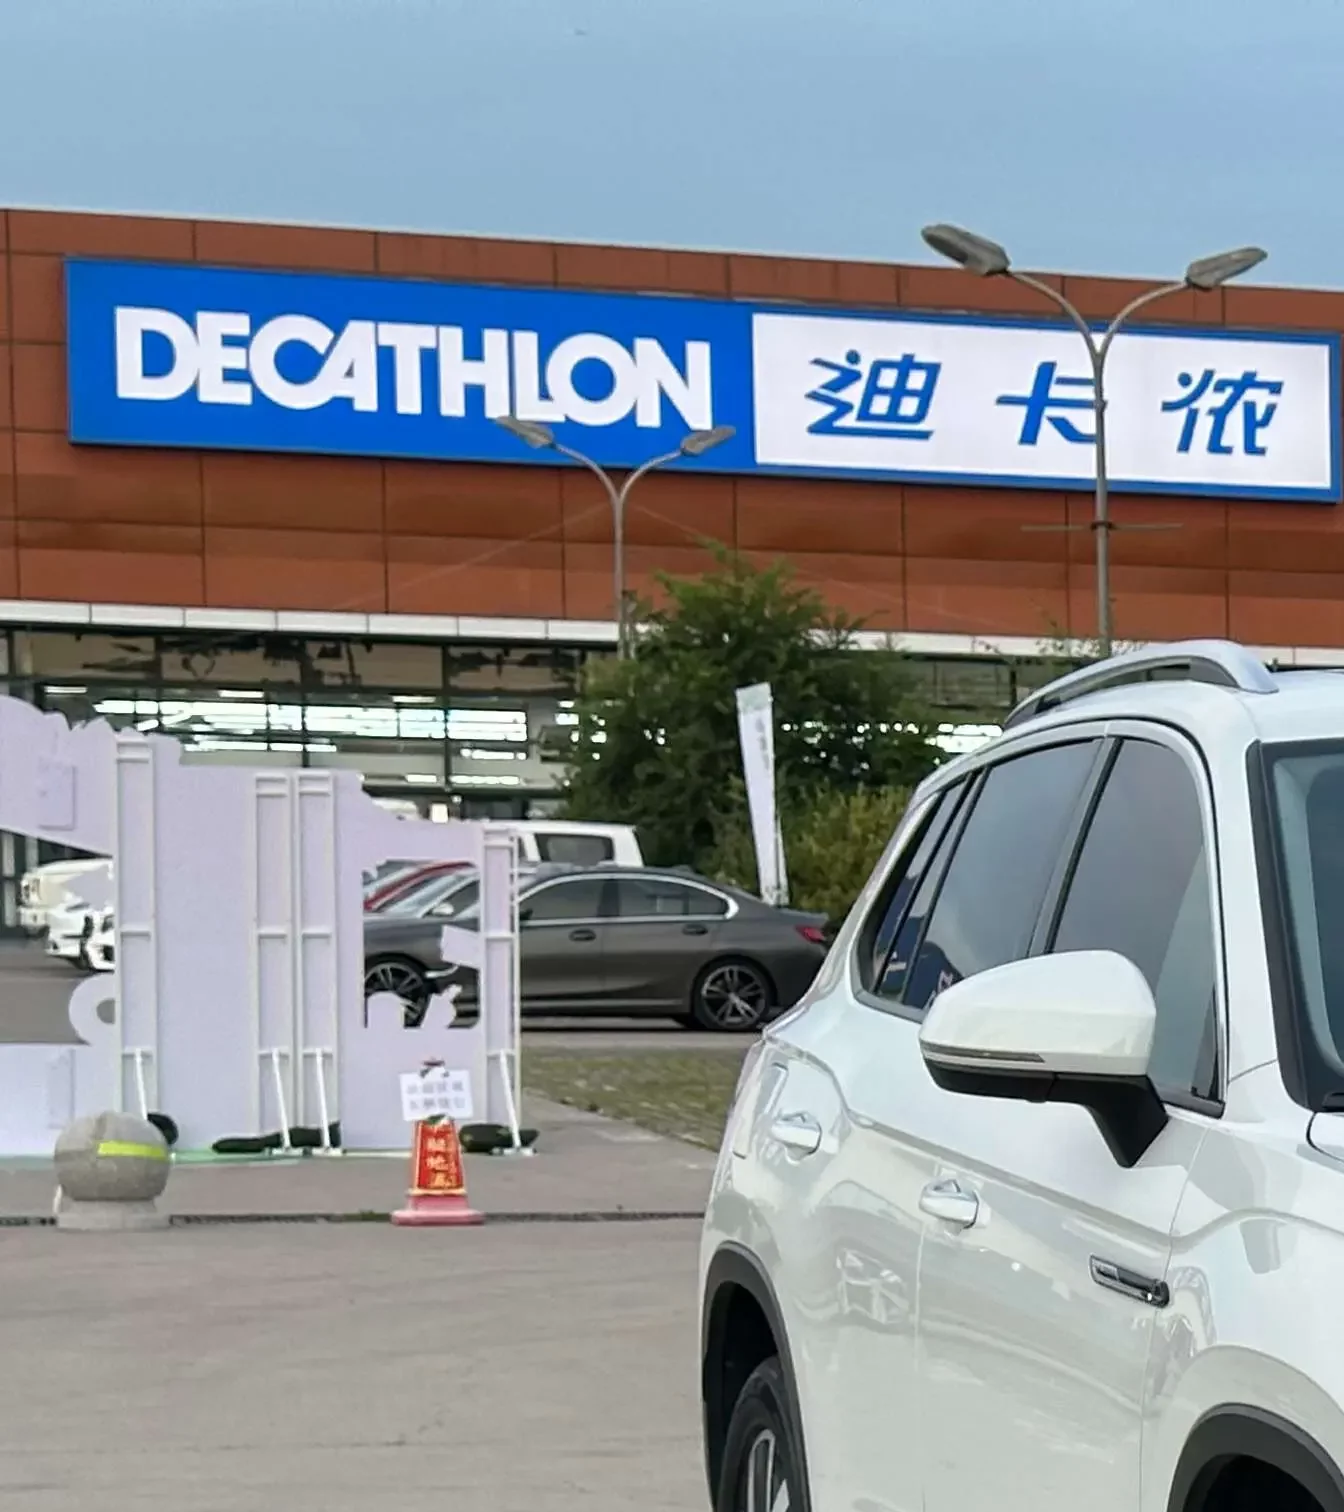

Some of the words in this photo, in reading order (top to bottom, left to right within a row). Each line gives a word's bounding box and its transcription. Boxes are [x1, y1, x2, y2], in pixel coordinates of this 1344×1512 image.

[115, 306, 712, 431] DECATHLON
[804, 349, 1284, 456] 迪卡侬
